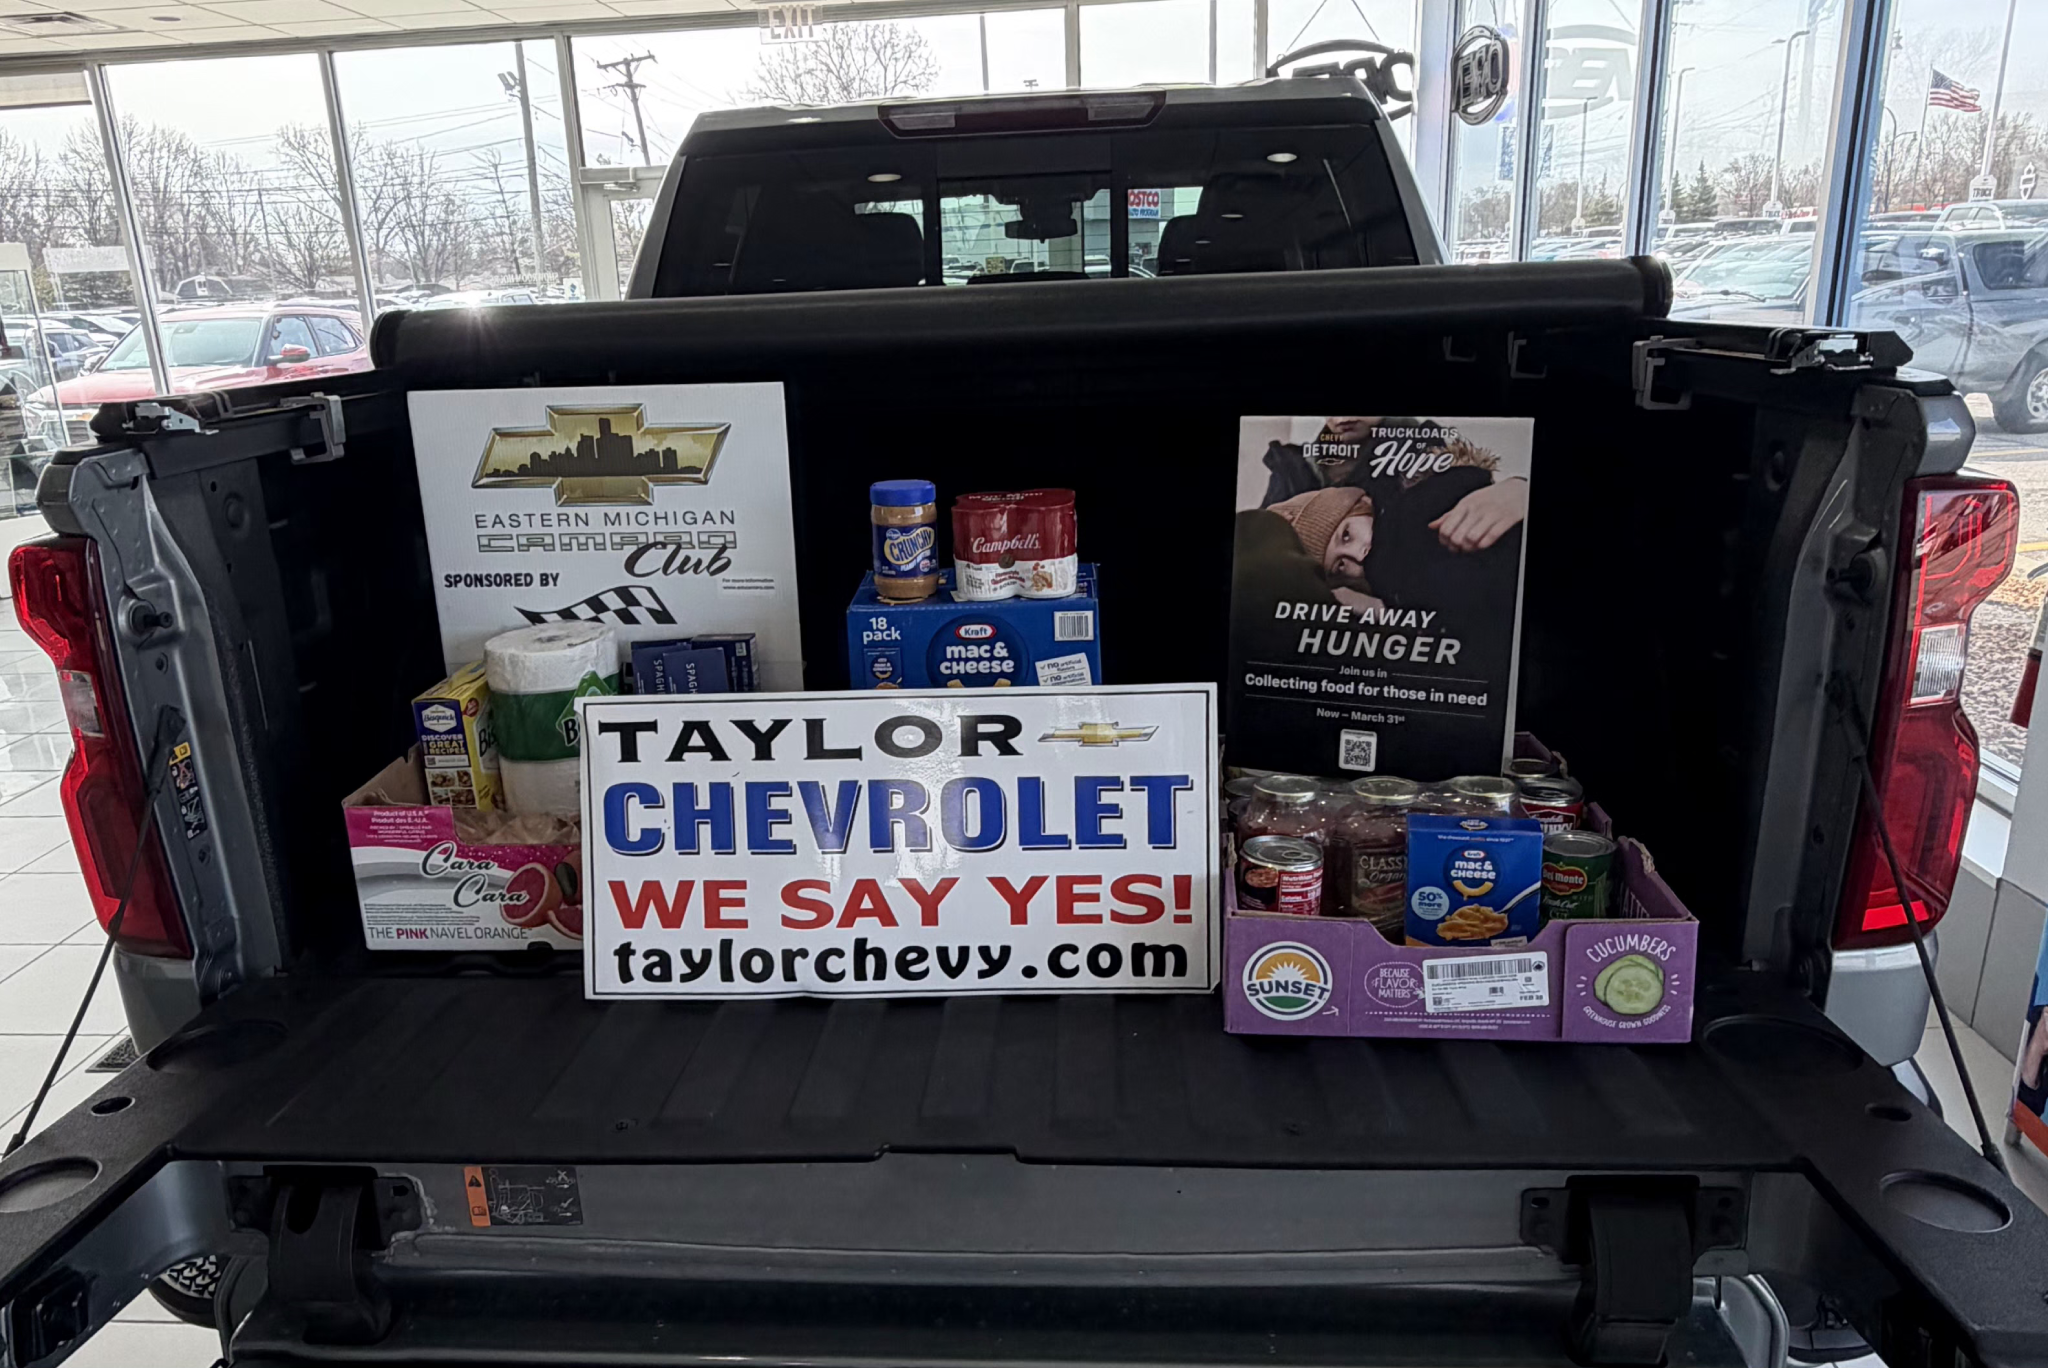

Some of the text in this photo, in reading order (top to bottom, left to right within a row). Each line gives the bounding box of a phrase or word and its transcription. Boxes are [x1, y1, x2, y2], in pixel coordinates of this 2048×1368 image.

[768, 4, 816, 39] EXIT
[1320, 433, 1344, 442] CHEVY
[1371, 427, 1459, 439] TRUCKLOADS
[1303, 443, 1360, 458] DETROIT
[1369, 439, 1454, 479] Hope
[475, 510, 735, 529] EASTERN MICHIGAN
[477, 531, 737, 552] CAMARO
[890, 529, 932, 562] CRUNCHY
[972, 533, 1041, 553] Campbell's
[624, 541, 733, 578] Club
[444, 573, 560, 588] SPONSORED BY
[869, 616, 888, 630] 18
[1275, 602, 1437, 628] DRIVE AWAY
[863, 626, 901, 645] pack
[964, 627, 988, 637] Kraft
[946, 641, 1009, 659] mac &
[1297, 628, 1461, 665] HUNGER
[1047, 658, 1082, 670] no artificial
[1338, 665, 1387, 678] Join us in
[1049, 671, 1085, 682] no artificial
[1245, 673, 1488, 706] Collecting food for those in need
[424, 714, 455, 723] Bisquick
[1316, 707, 1340, 719] Now
[1351, 711, 1385, 724] March
[1387, 714, 1405, 725] 31st
[599, 714, 1024, 763] TAYLOR
[603, 774, 1194, 856] CHEVROLET
[421, 841, 496, 877] Cara
[1455, 861, 1493, 870] mac &
[1555, 872, 1584, 885] Monte
[453, 873, 528, 908] Cara
[1418, 891, 1443, 902] 50%
[608, 874, 1193, 930] WE SAY YES!
[367, 926, 394, 939] THE
[396, 928, 429, 940] PINK
[430, 927, 474, 939] NAVEL
[1586, 934, 1677, 962] CUCUMBERS
[613, 938, 1188, 984] taylorchevy.com
[1379, 968, 1410, 978] BECAUSE
[1247, 980, 1330, 1001] SUNSET
[1374, 978, 1416, 989] FLAVOR
[1378, 988, 1411, 999] MATTERS
[1583, 1004, 1671, 1029] GREENHOUSE GROWN GOODNESS
